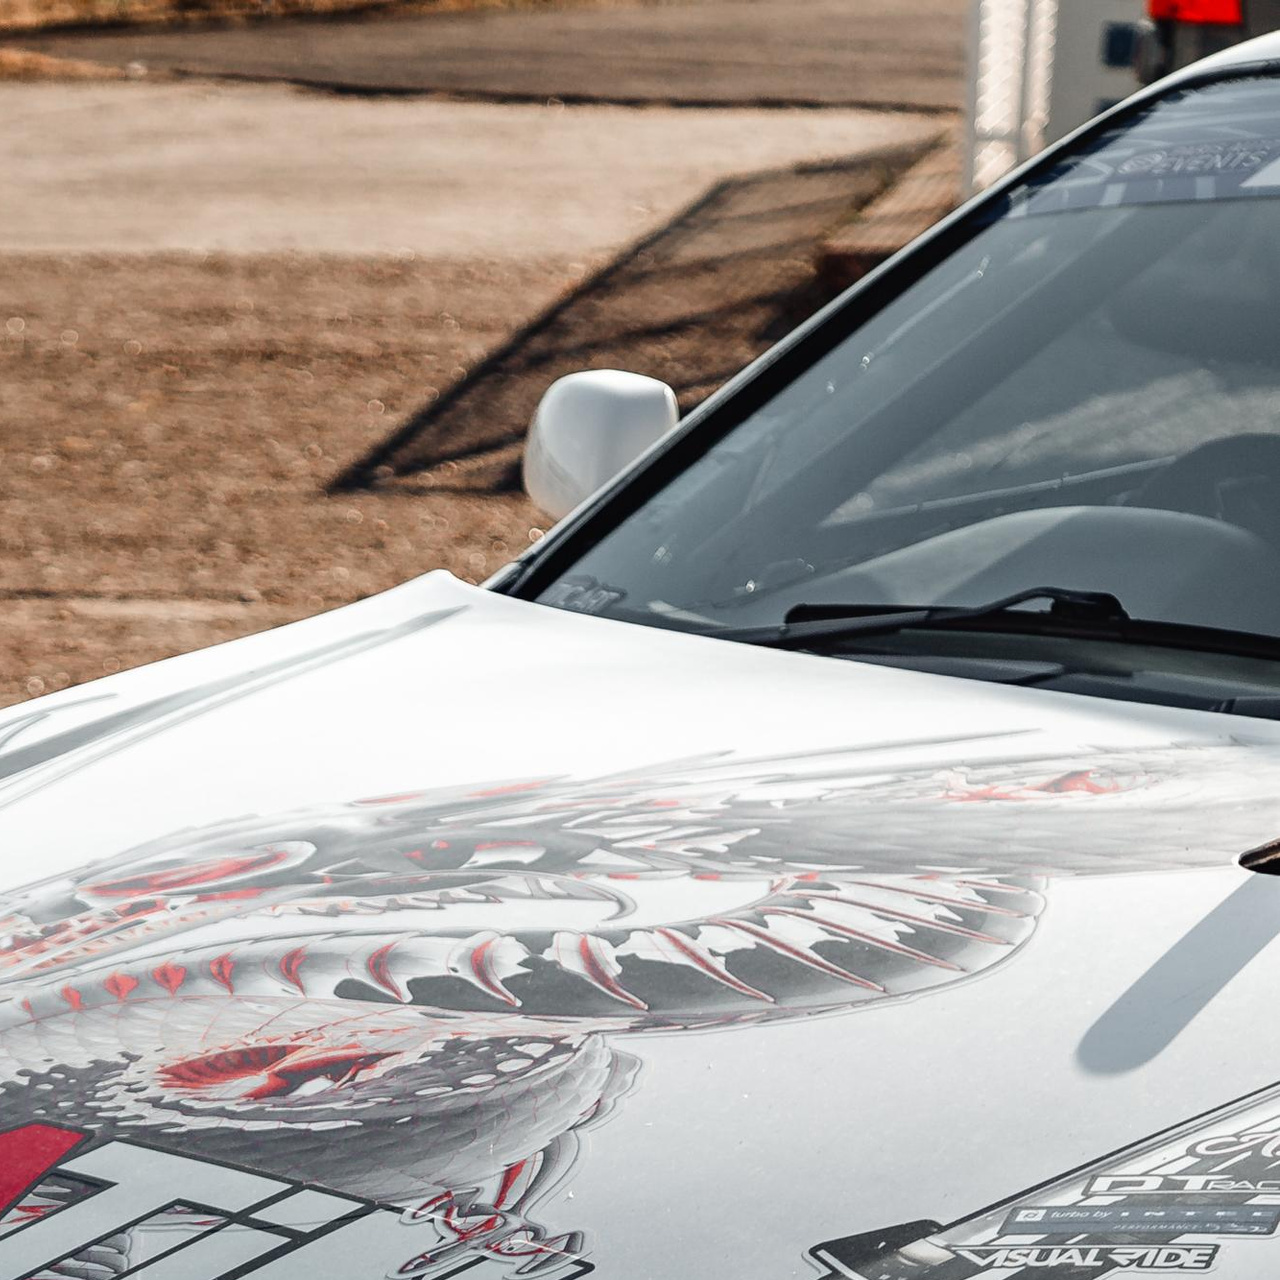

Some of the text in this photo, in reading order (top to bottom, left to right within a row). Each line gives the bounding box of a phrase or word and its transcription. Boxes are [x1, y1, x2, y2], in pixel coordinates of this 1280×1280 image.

[1050, 1209, 1090, 1218] turbo
[1093, 1209, 1113, 1219] by
[955, 1248, 1215, 1268] VISUAL RIDE
